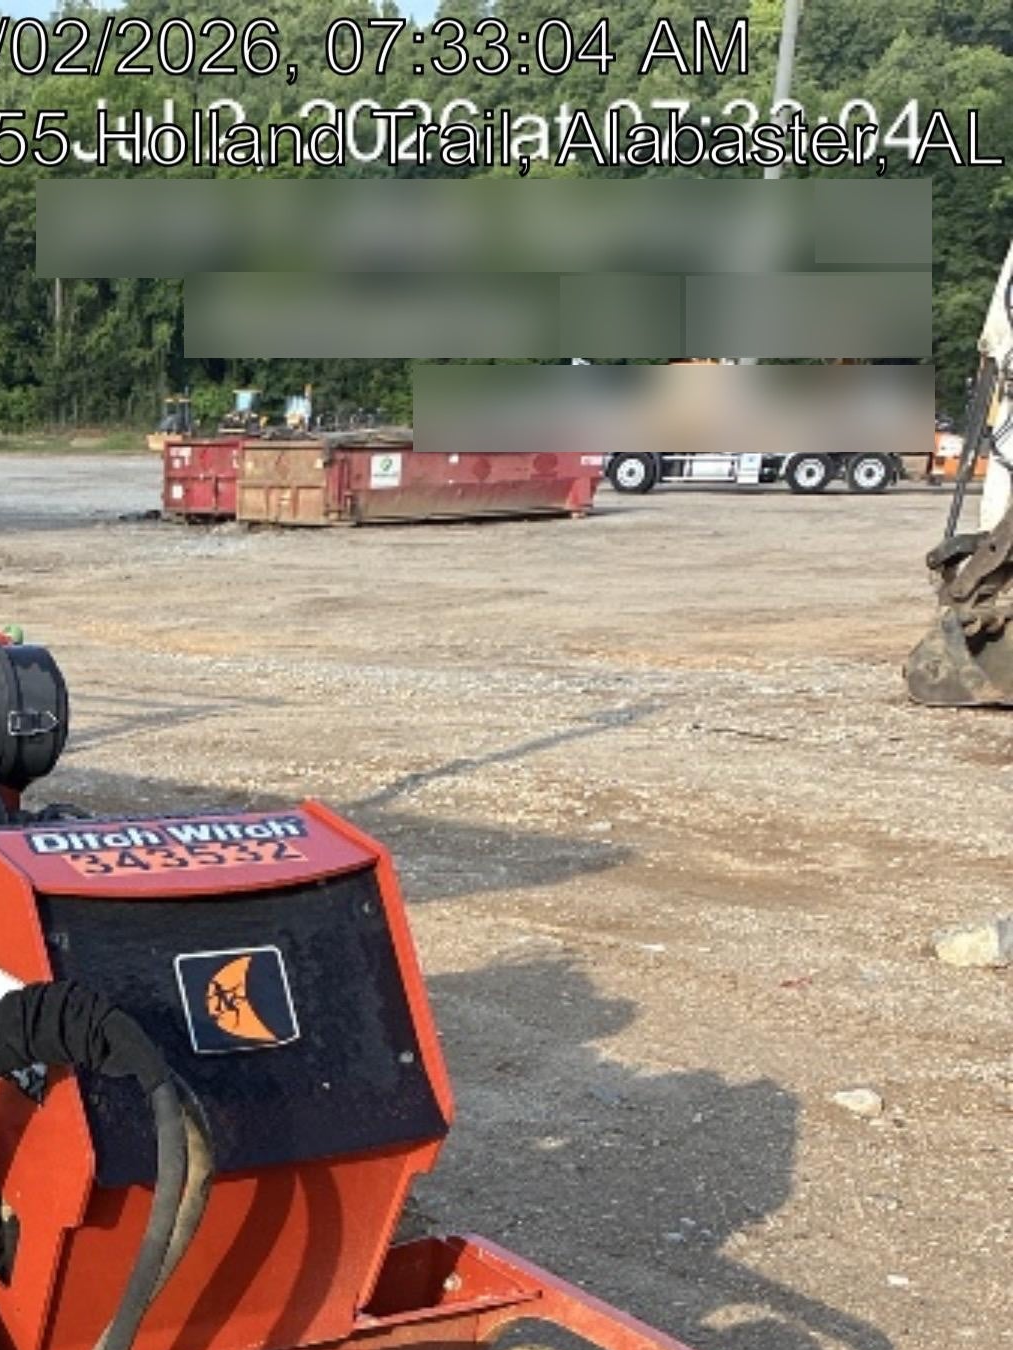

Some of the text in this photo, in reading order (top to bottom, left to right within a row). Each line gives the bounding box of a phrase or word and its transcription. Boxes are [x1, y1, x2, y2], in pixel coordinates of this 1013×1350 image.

[31, 816, 302, 854] Ditch Witch
[69, 839, 303, 876] 343532
